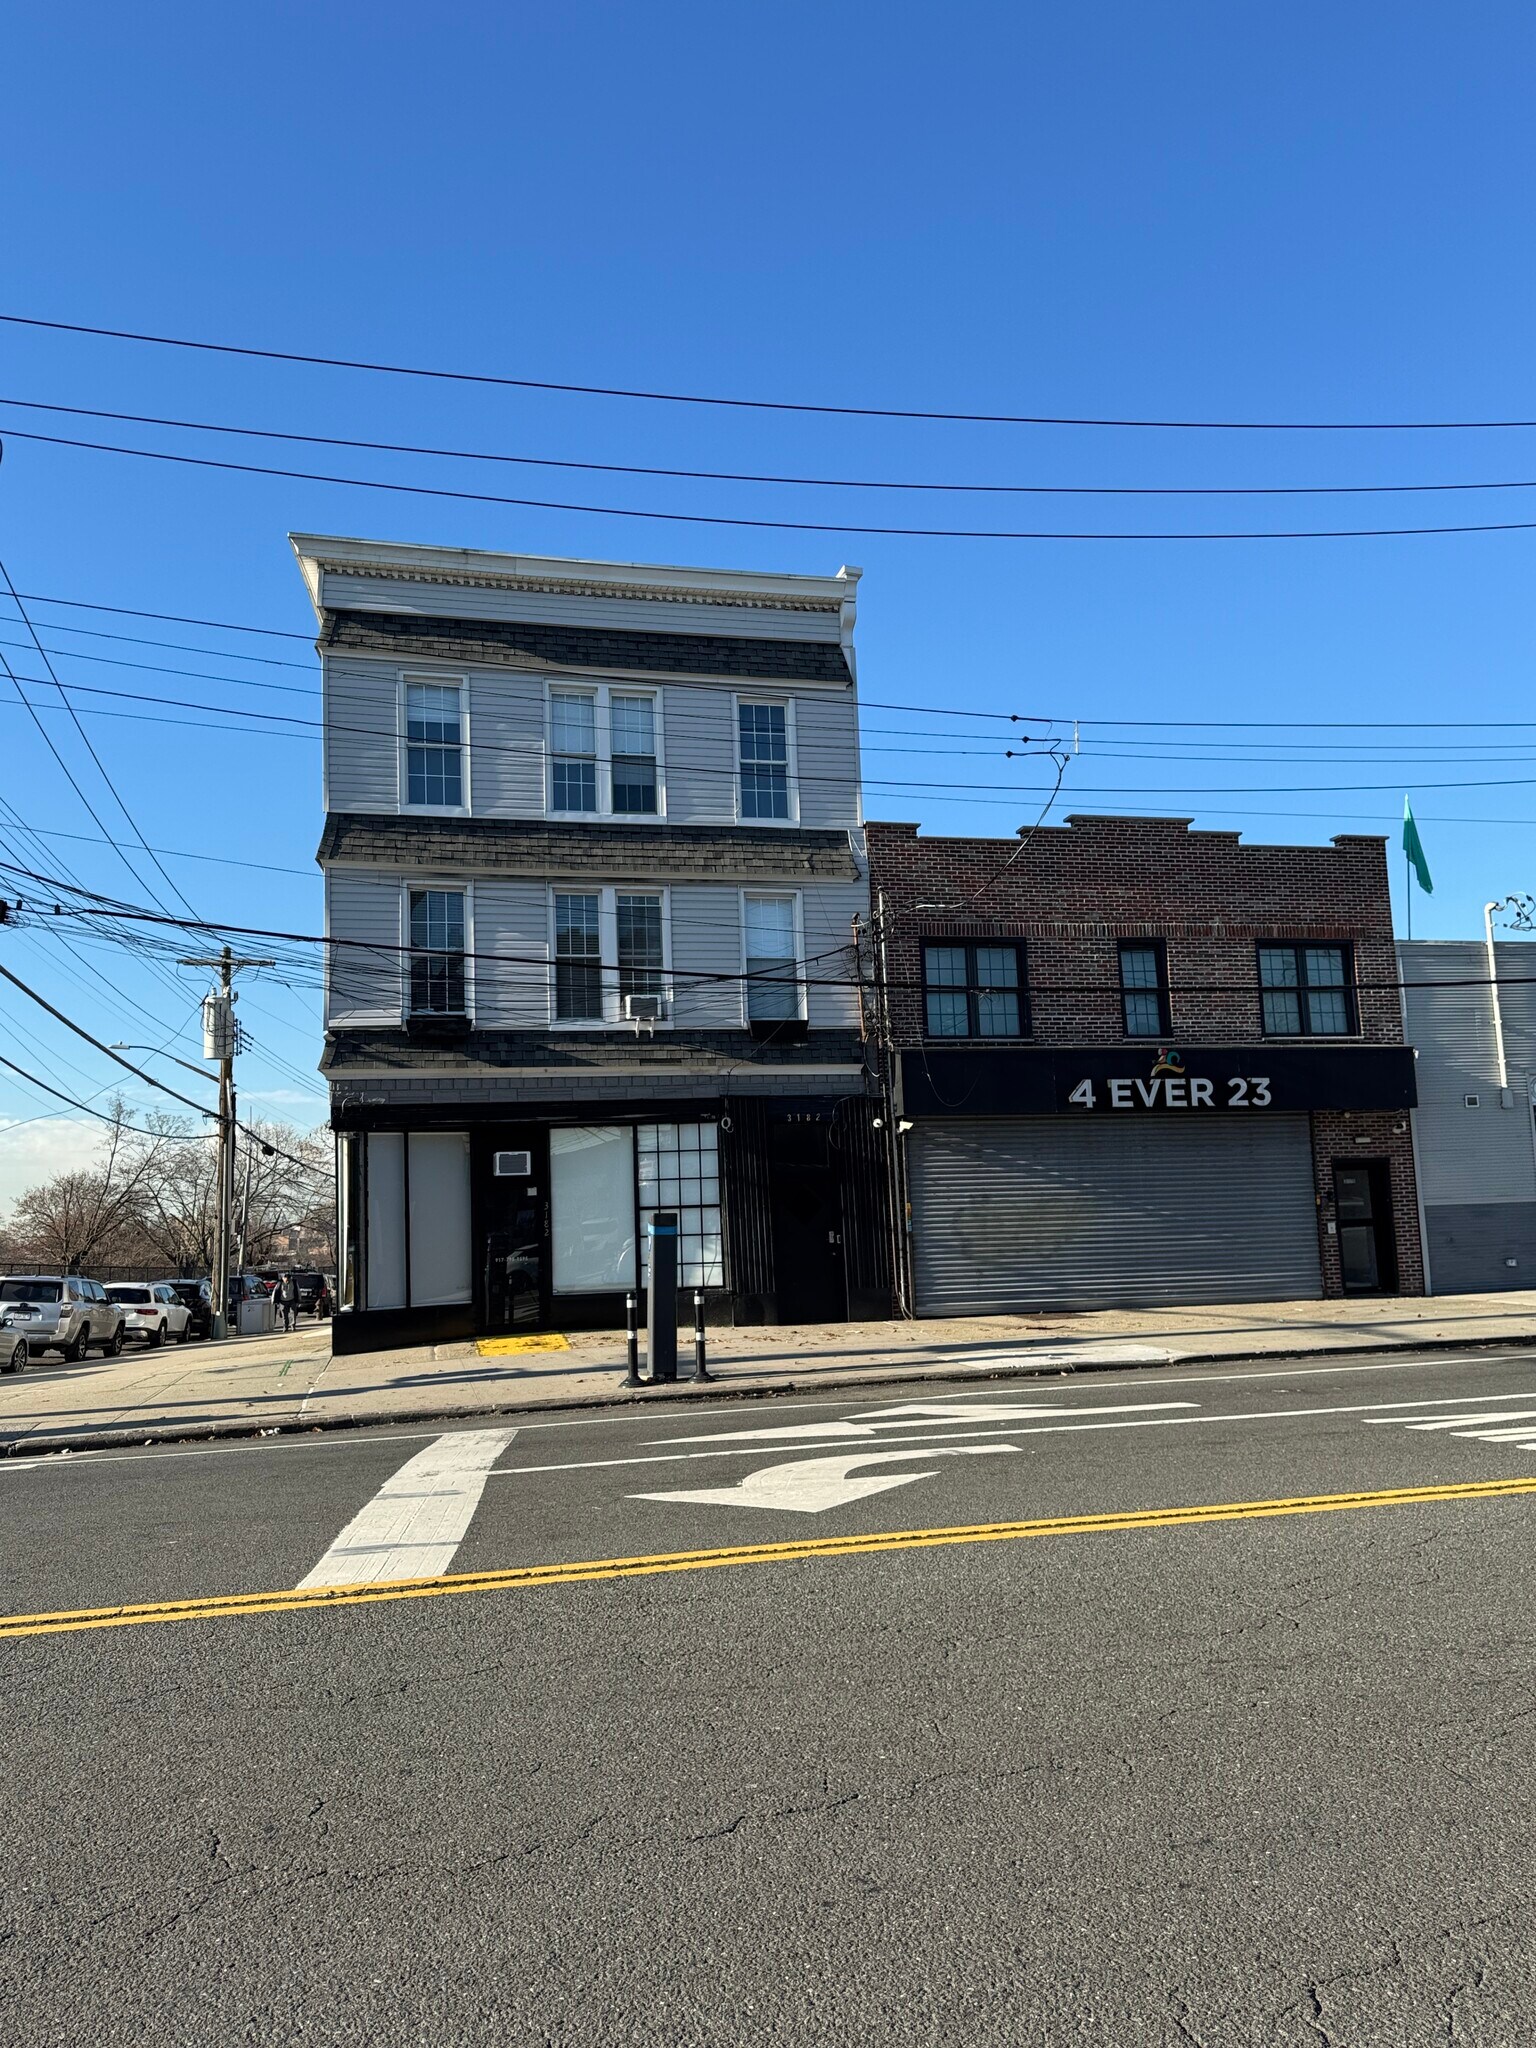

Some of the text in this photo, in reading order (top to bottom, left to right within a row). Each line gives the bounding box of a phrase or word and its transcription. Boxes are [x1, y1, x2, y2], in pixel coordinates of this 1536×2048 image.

[1069, 1077, 1272, 1108] 4 EVER 23
[786, 1113, 821, 1122] 3182
